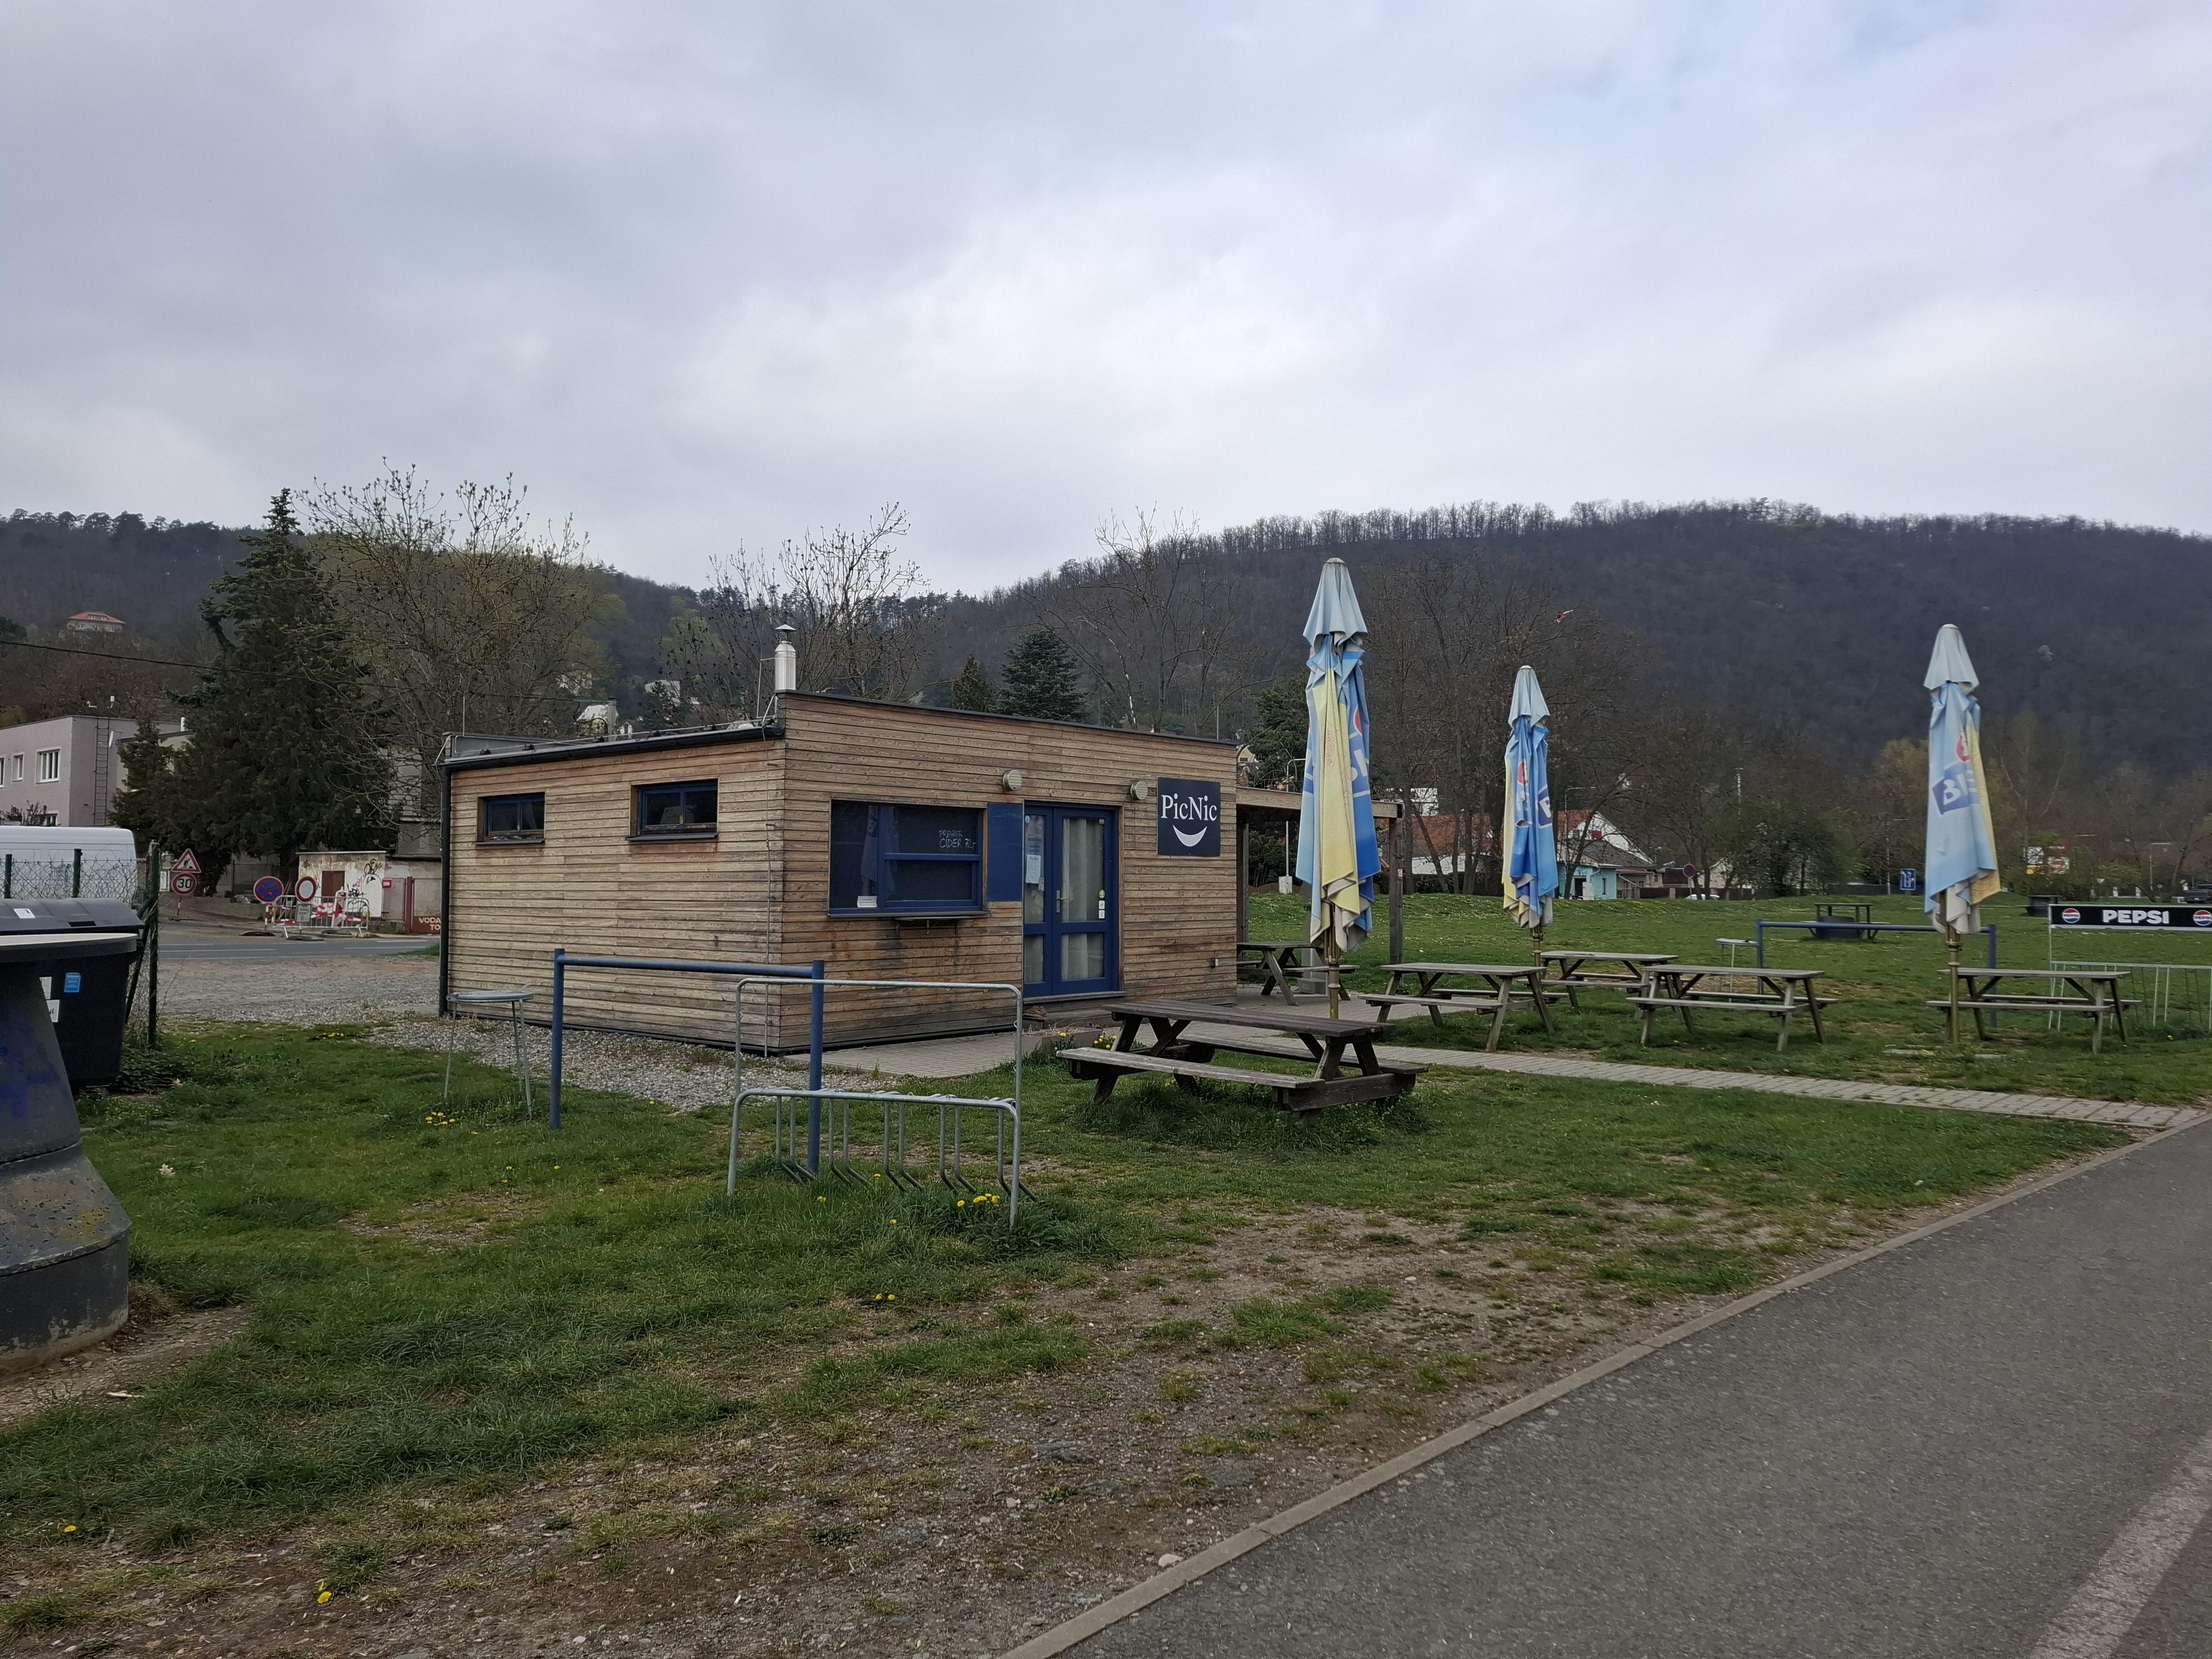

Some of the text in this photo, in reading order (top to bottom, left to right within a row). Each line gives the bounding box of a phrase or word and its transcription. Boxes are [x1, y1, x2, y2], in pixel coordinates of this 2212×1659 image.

[1161, 793, 1217, 821] PicNic
[940, 838, 963, 849] CIDER
[178, 878, 192, 888] 30
[2103, 910, 2169, 924] PEPSI
